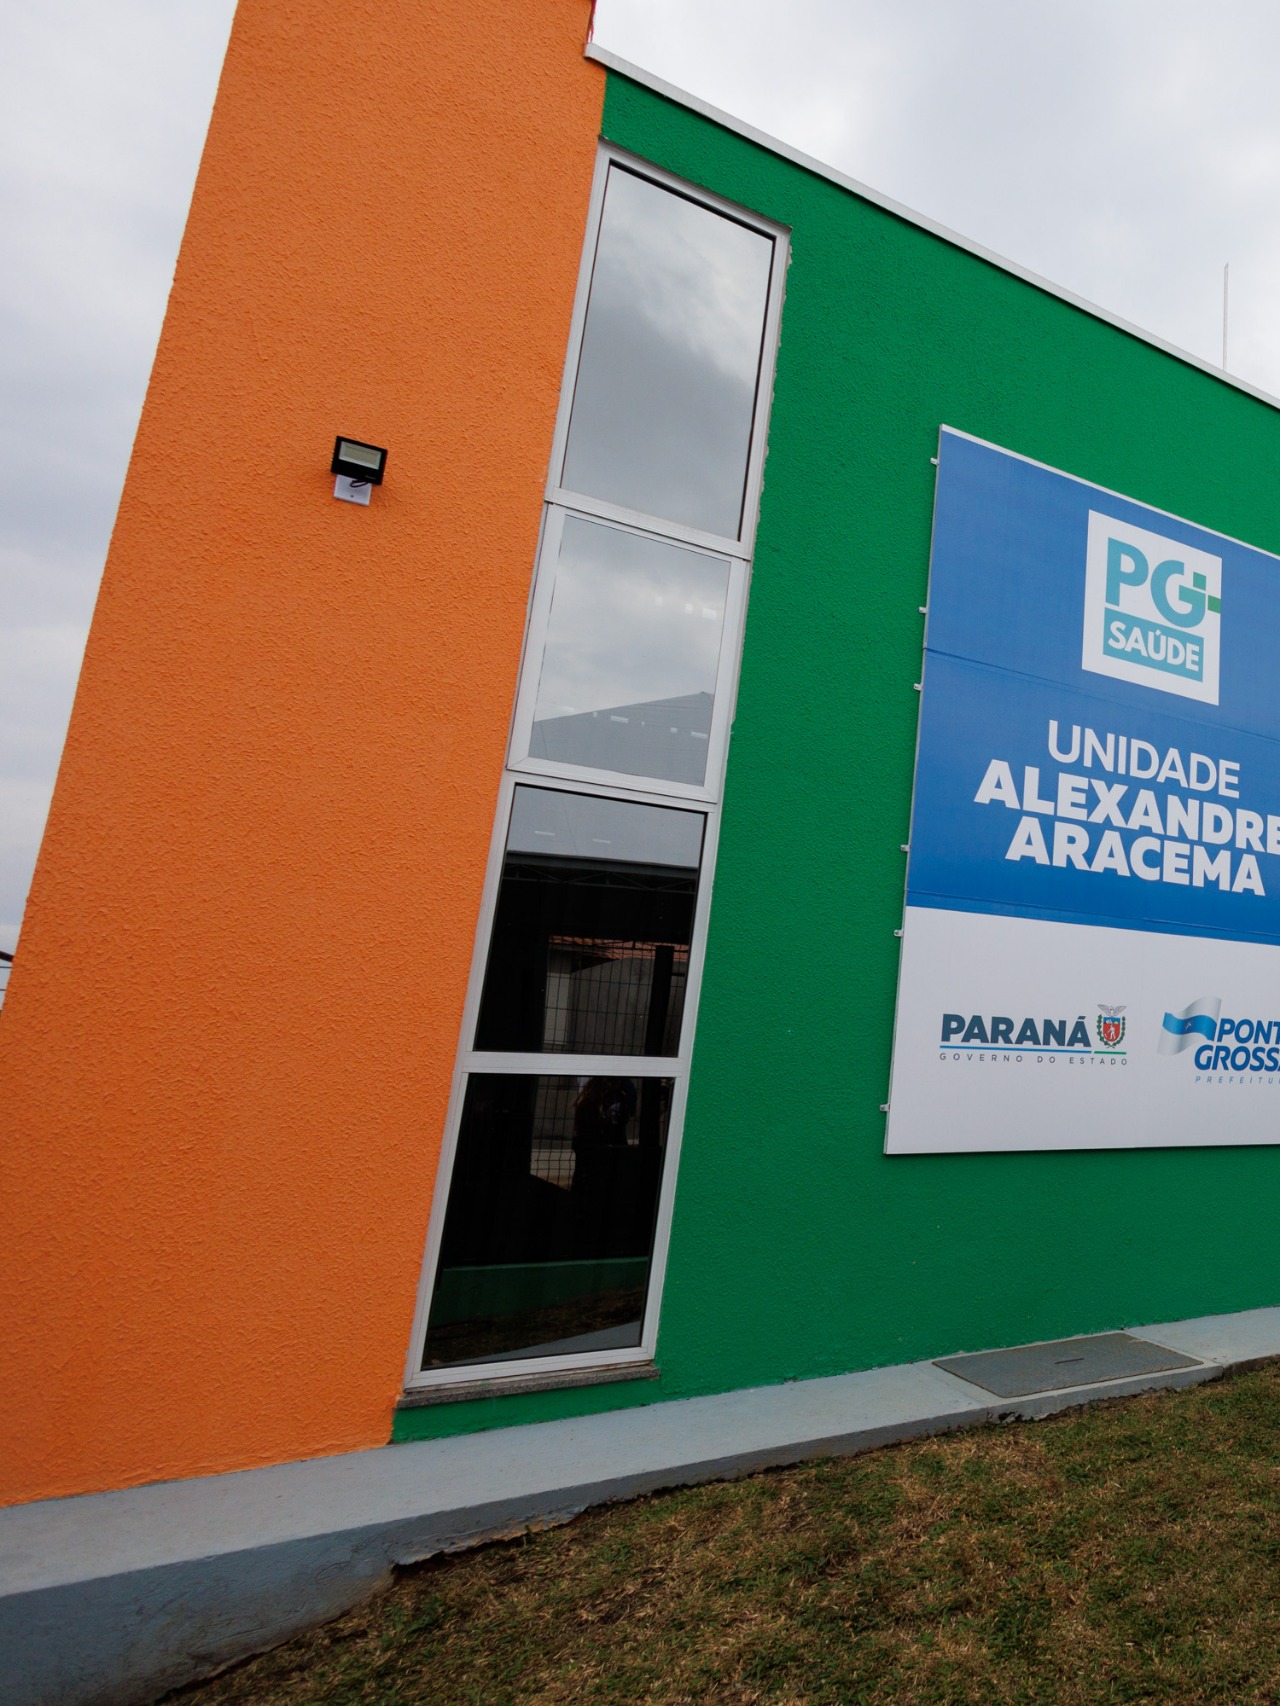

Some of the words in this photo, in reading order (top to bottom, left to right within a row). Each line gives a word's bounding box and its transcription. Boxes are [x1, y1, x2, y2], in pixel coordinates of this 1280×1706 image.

[1108, 621, 1200, 672] SAÚDE
[1048, 719, 1241, 799] UNIDADE
[1005, 817, 1266, 897] ARACEMA
[941, 1013, 1092, 1047] PARANÁ
[939, 1052, 1024, 1064] GOVERNO
[1037, 1055, 1056, 1064] DO
[1069, 1056, 1128, 1066] ESTADO
